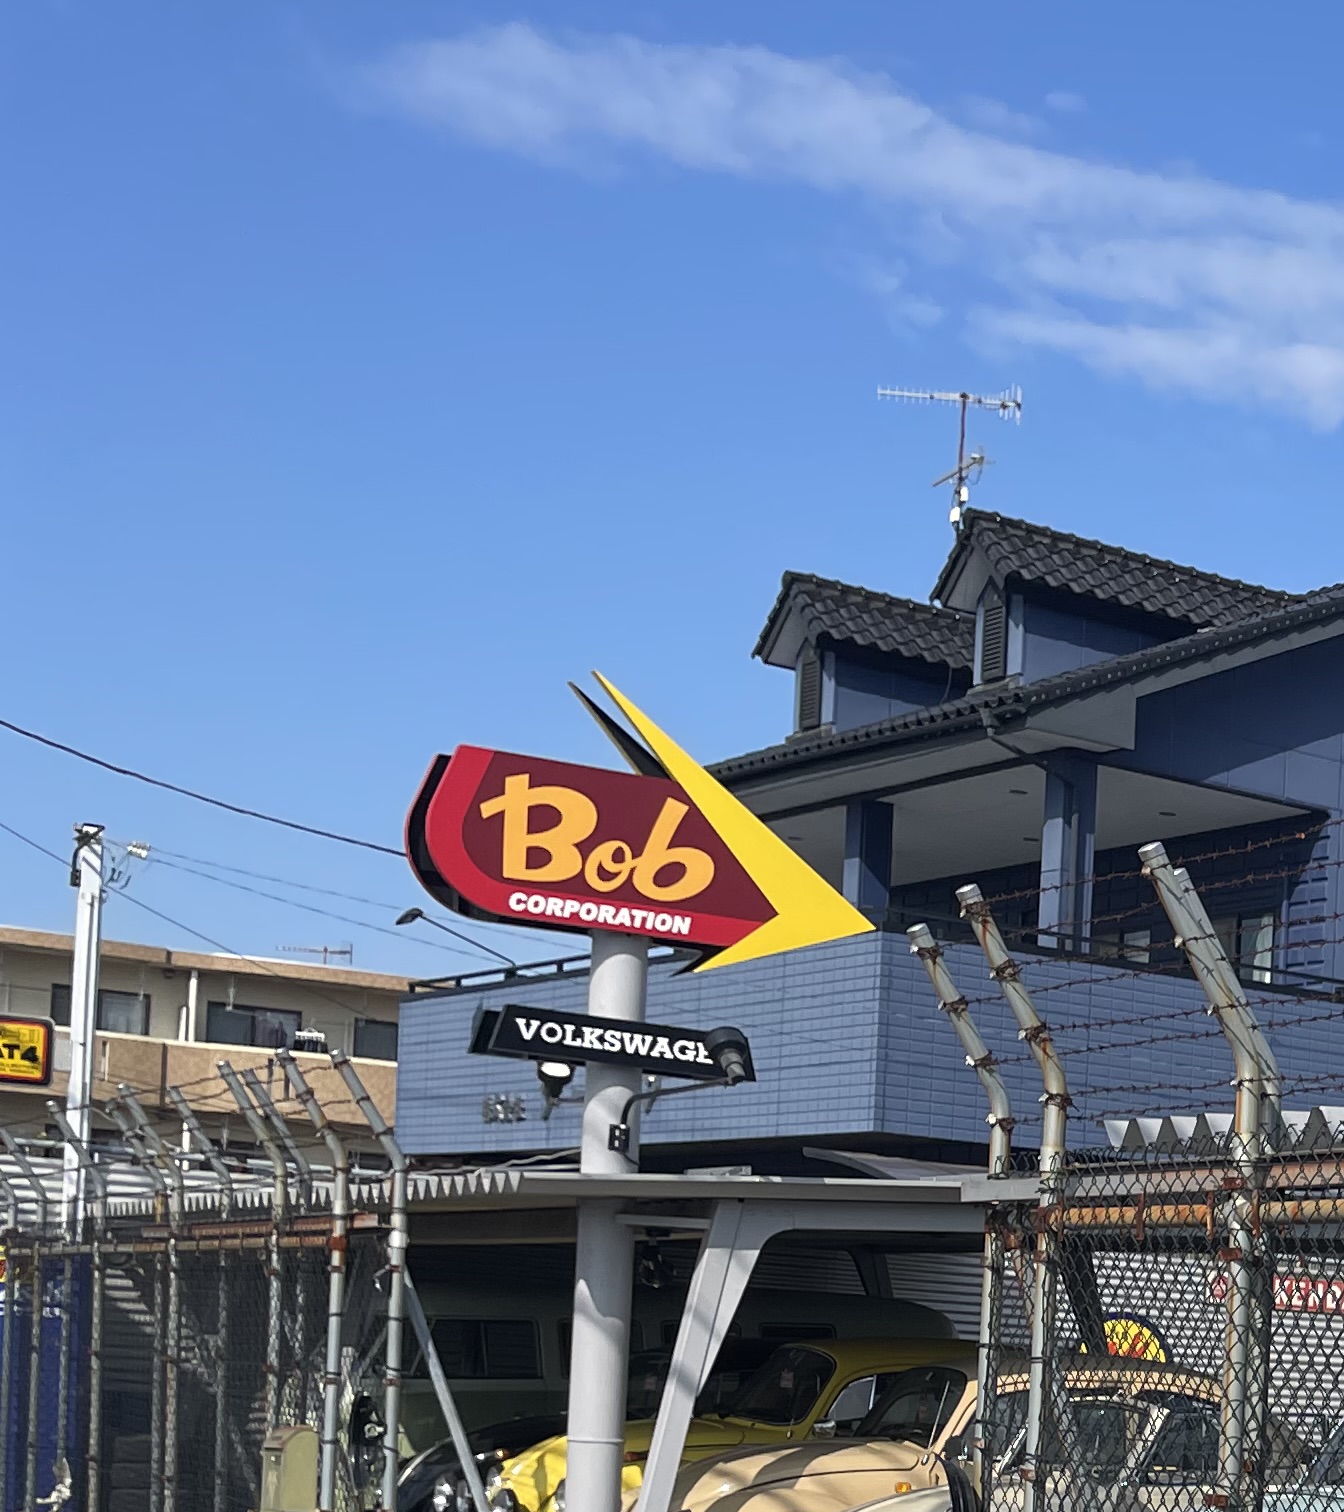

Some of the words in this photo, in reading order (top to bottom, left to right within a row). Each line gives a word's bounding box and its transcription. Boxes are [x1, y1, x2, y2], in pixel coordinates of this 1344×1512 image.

[479, 773, 715, 902] Bob
[508, 892, 691, 935] CORPORATION
[515, 1017, 714, 1065] VOLKSWAGE
